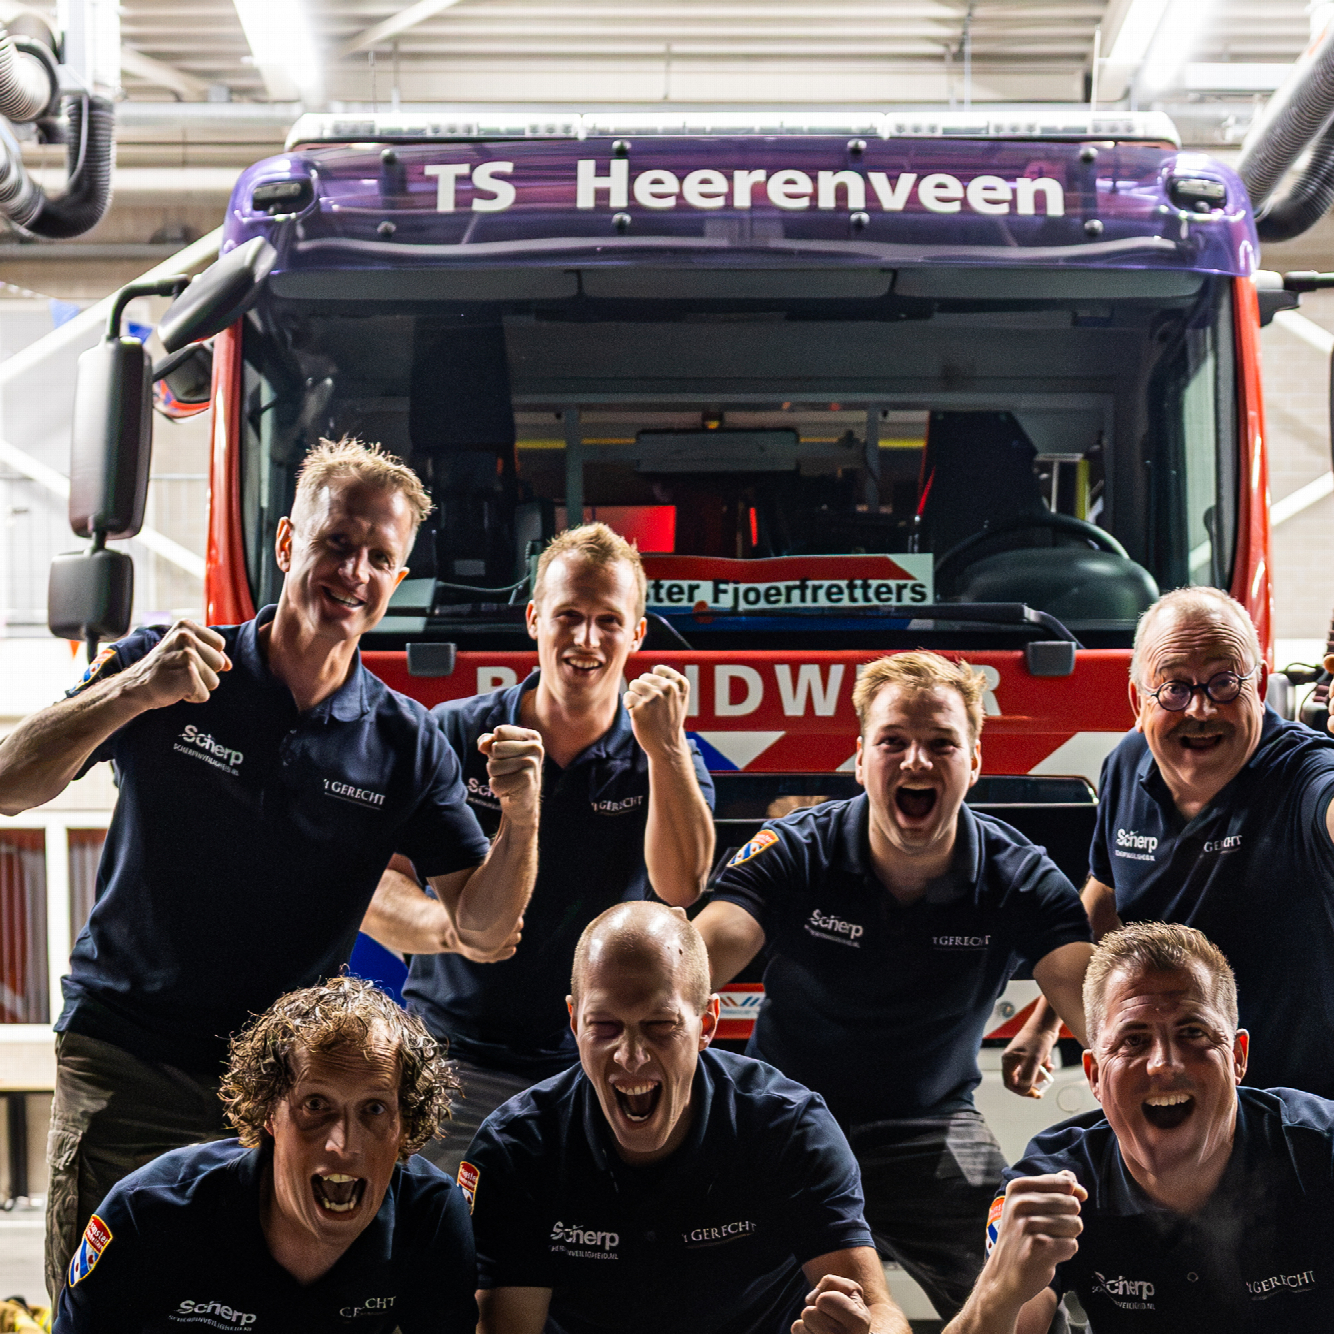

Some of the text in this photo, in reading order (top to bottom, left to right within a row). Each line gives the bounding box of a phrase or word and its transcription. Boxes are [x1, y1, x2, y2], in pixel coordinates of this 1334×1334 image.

[424, 158, 1066, 216] TS Heerenveen
[712, 577, 927, 611] Fjoerfretters
[178, 724, 244, 766] Scherp
[331, 781, 386, 805] GERECHT
[1117, 828, 1158, 853] Scherp
[809, 909, 864, 940] Scherp
[548, 1221, 620, 1251] Scherp
[690, 1220, 757, 1242] GERECHT
[1253, 1270, 1316, 1294] GERECHT
[175, 1300, 257, 1326] Scherp
